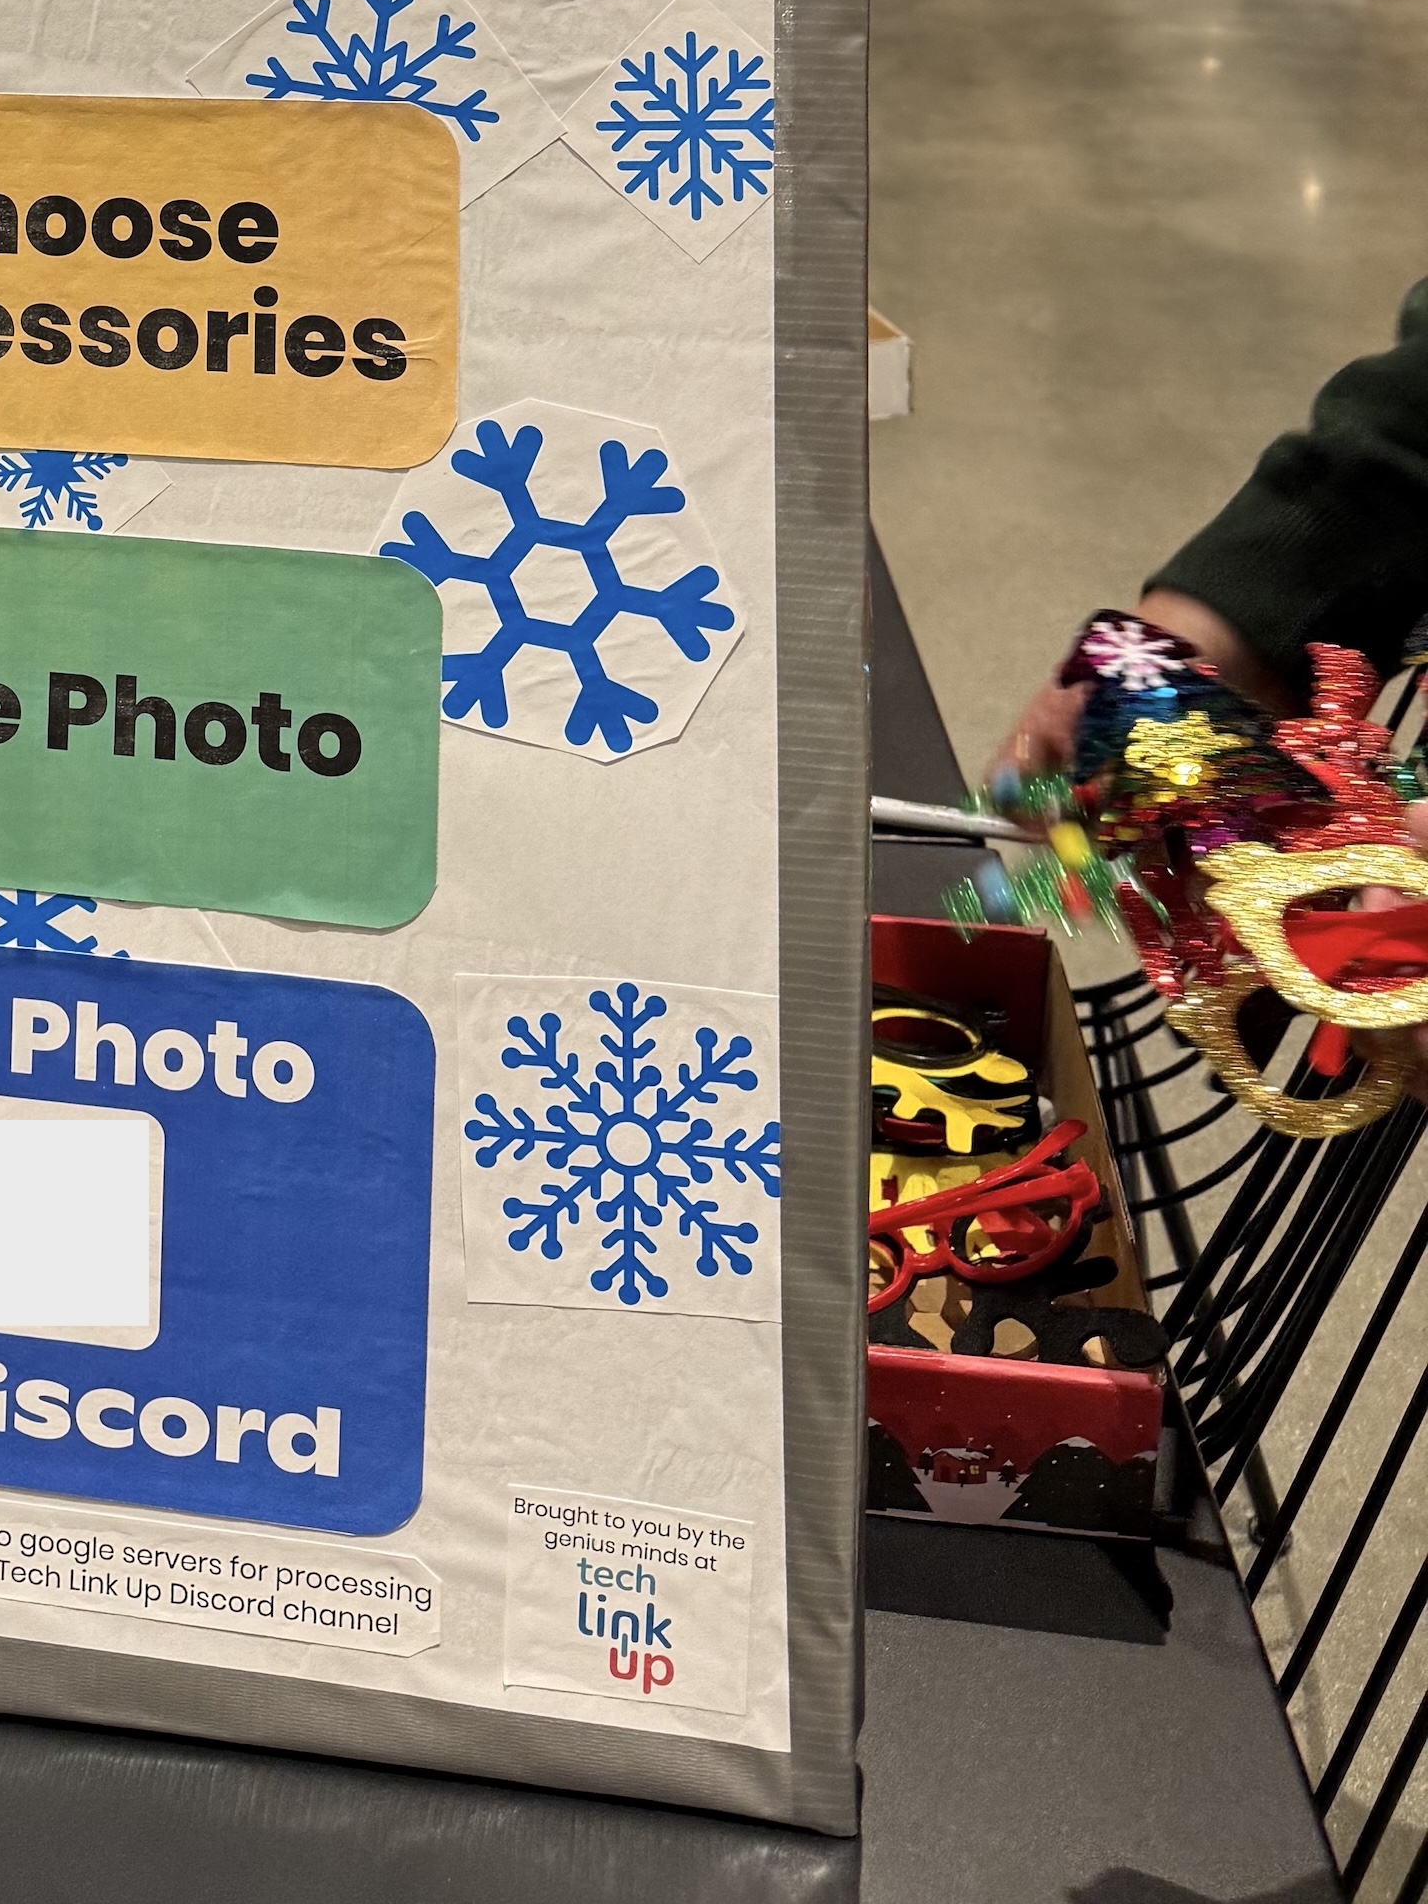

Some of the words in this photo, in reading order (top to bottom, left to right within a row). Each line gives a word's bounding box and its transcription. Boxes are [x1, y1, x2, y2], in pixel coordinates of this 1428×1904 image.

[46, 670, 363, 778] Photo
[10, 996, 316, 1104] Photo
[514, 1497, 599, 1526] Brought
[604, 1511, 626, 1529] to
[631, 1518, 671, 1538] you
[677, 1522, 704, 1548] by
[709, 1529, 746, 1550] the
[544, 1531, 616, 1554] genius
[621, 1542, 689, 1567] minds
[694, 1554, 718, 1572] at
[20, 1533, 115, 1564] google
[122, 1544, 222, 1575] servers
[230, 1555, 269, 1581] for
[276, 1566, 433, 1612] processing
[577, 1557, 656, 1596] tech
[69, 1568, 118, 1597] Link
[125, 1576, 162, 1607] Up
[170, 1582, 275, 1618] Discord
[283, 1599, 398, 1636] channel
[578, 1591, 673, 1649] link
[609, 1647, 675, 1695] up
